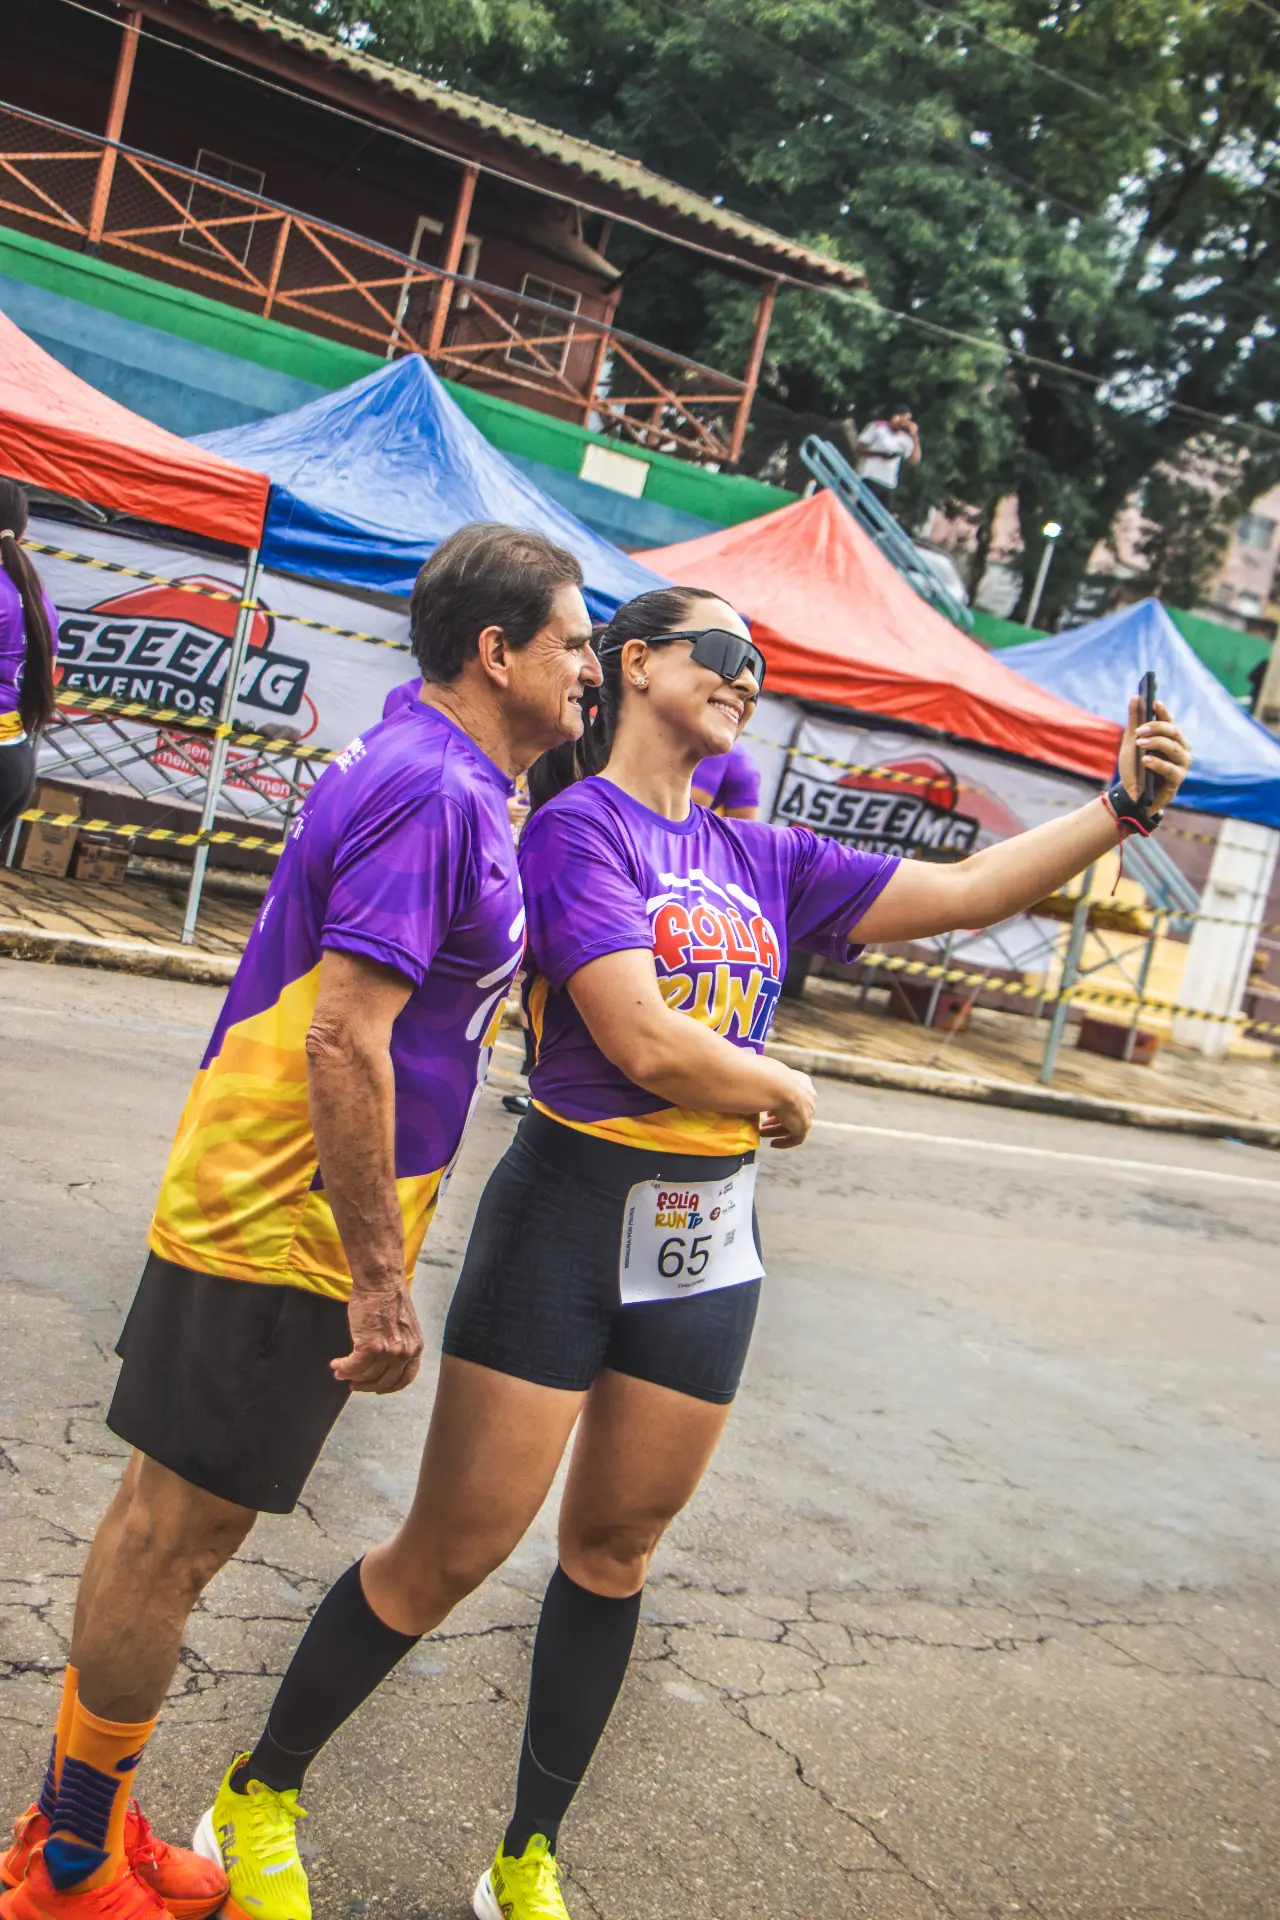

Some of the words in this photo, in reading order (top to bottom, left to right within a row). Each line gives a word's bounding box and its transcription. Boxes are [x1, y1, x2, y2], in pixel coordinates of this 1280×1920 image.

[57, 619, 303, 708] SSEEMG
[67, 672, 215, 718] EVENTOS
[781, 783, 974, 850] ASSEEMG
[657, 1235, 713, 1278] 65
